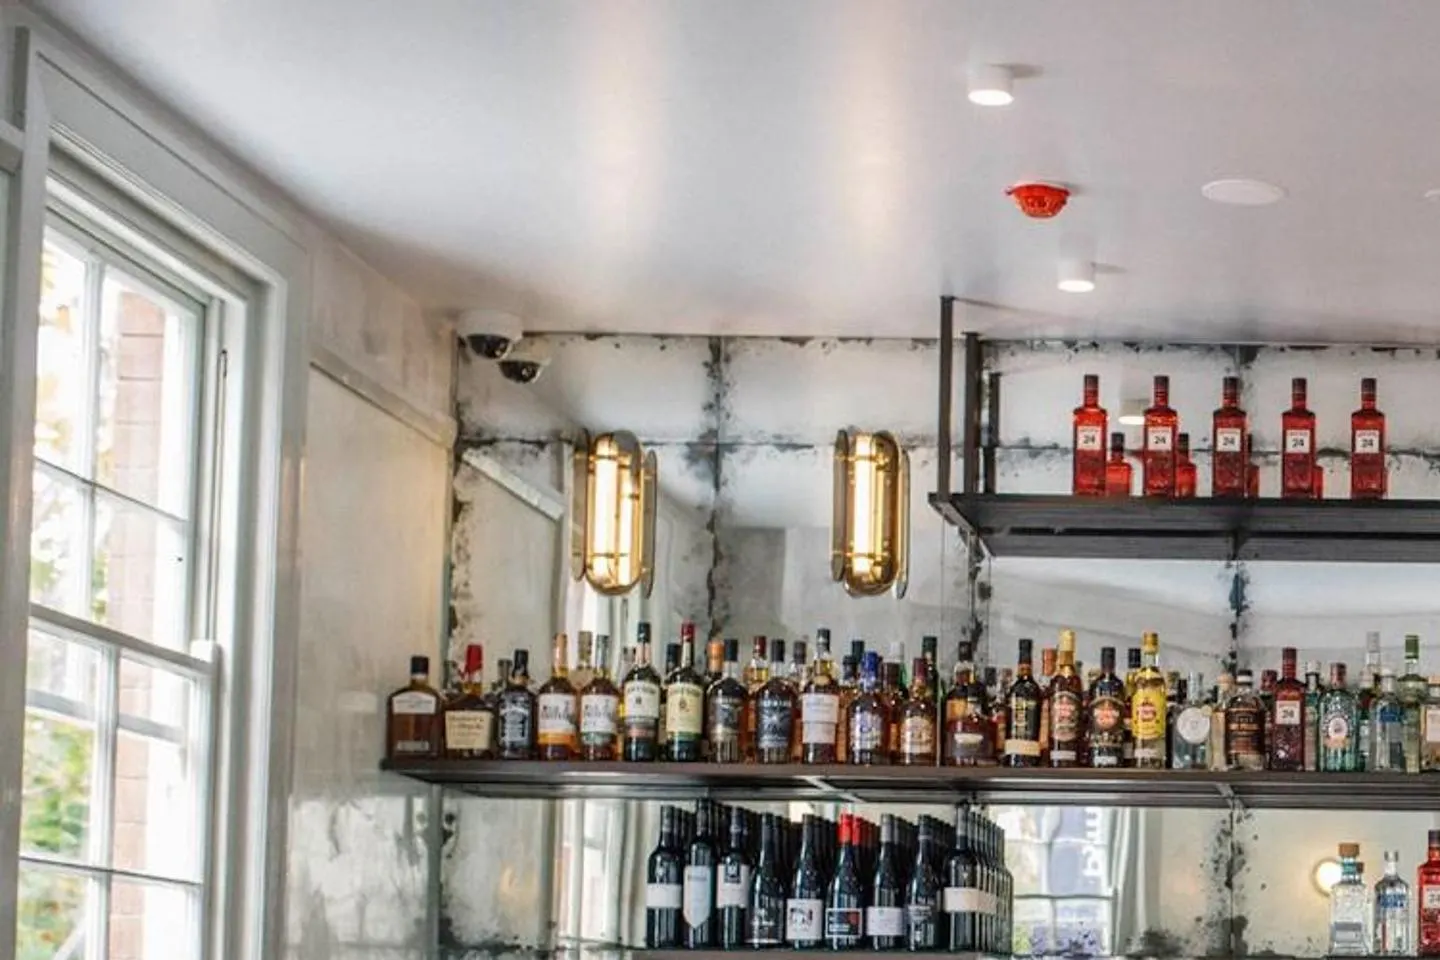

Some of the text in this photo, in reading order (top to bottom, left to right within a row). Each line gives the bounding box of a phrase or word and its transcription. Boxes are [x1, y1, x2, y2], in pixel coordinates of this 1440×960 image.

[1083, 434, 1096, 445] 24
[1154, 435, 1167, 445] 24
[1222, 436, 1236, 446] 24
[1291, 438, 1305, 448] 24
[1361, 438, 1374, 448] 24
[1281, 708, 1295, 719] 24
